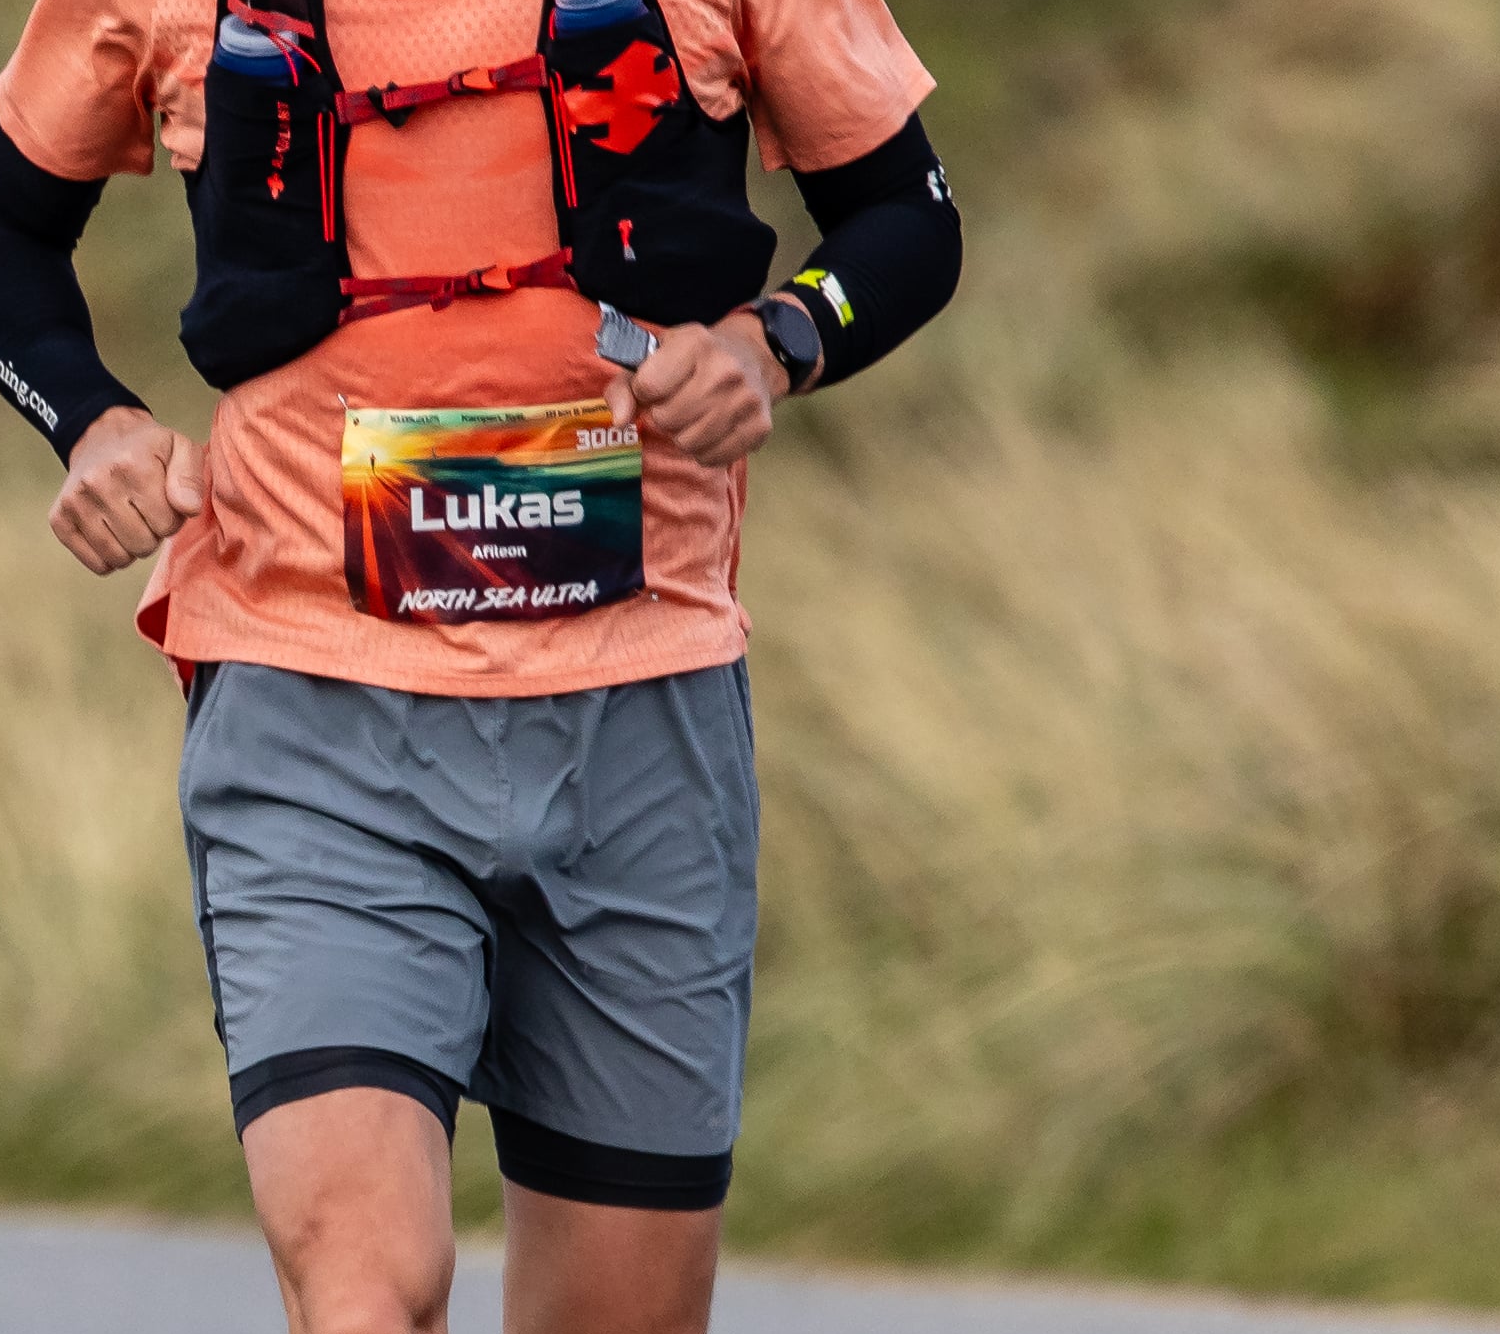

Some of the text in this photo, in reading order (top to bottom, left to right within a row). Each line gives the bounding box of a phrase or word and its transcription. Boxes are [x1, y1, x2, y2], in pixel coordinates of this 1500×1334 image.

[575, 424, 639, 451] 3006
[410, 484, 585, 532] Lukas
[398, 579, 600, 614] NORTH SEA ULTRA
